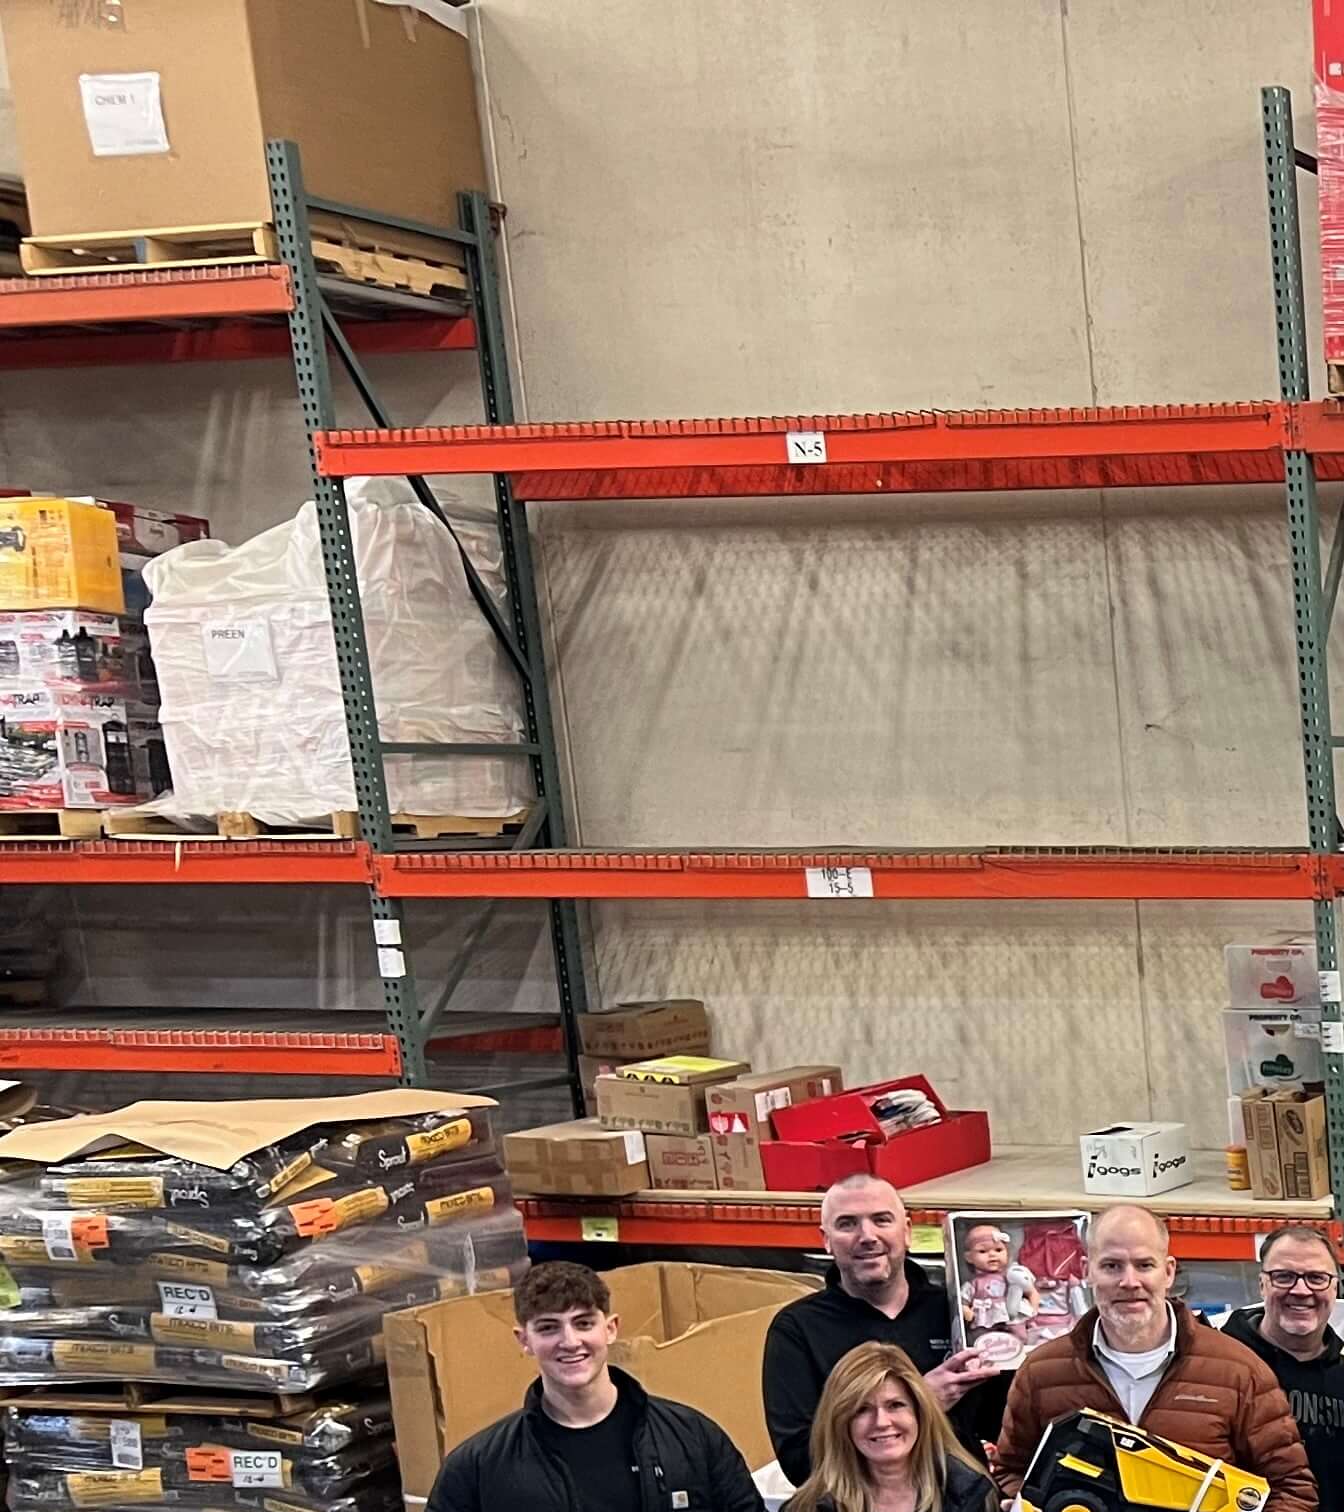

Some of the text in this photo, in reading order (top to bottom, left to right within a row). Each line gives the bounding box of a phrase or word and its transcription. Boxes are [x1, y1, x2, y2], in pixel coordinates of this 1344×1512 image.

[795, 441, 822, 457] N-5
[211, 629, 245, 639] PREEN
[821, 868, 852, 881] 100-E
[829, 882, 854, 894] 15-5
[163, 1285, 211, 1301] REC'D
[233, 1455, 279, 1470] REC'D
